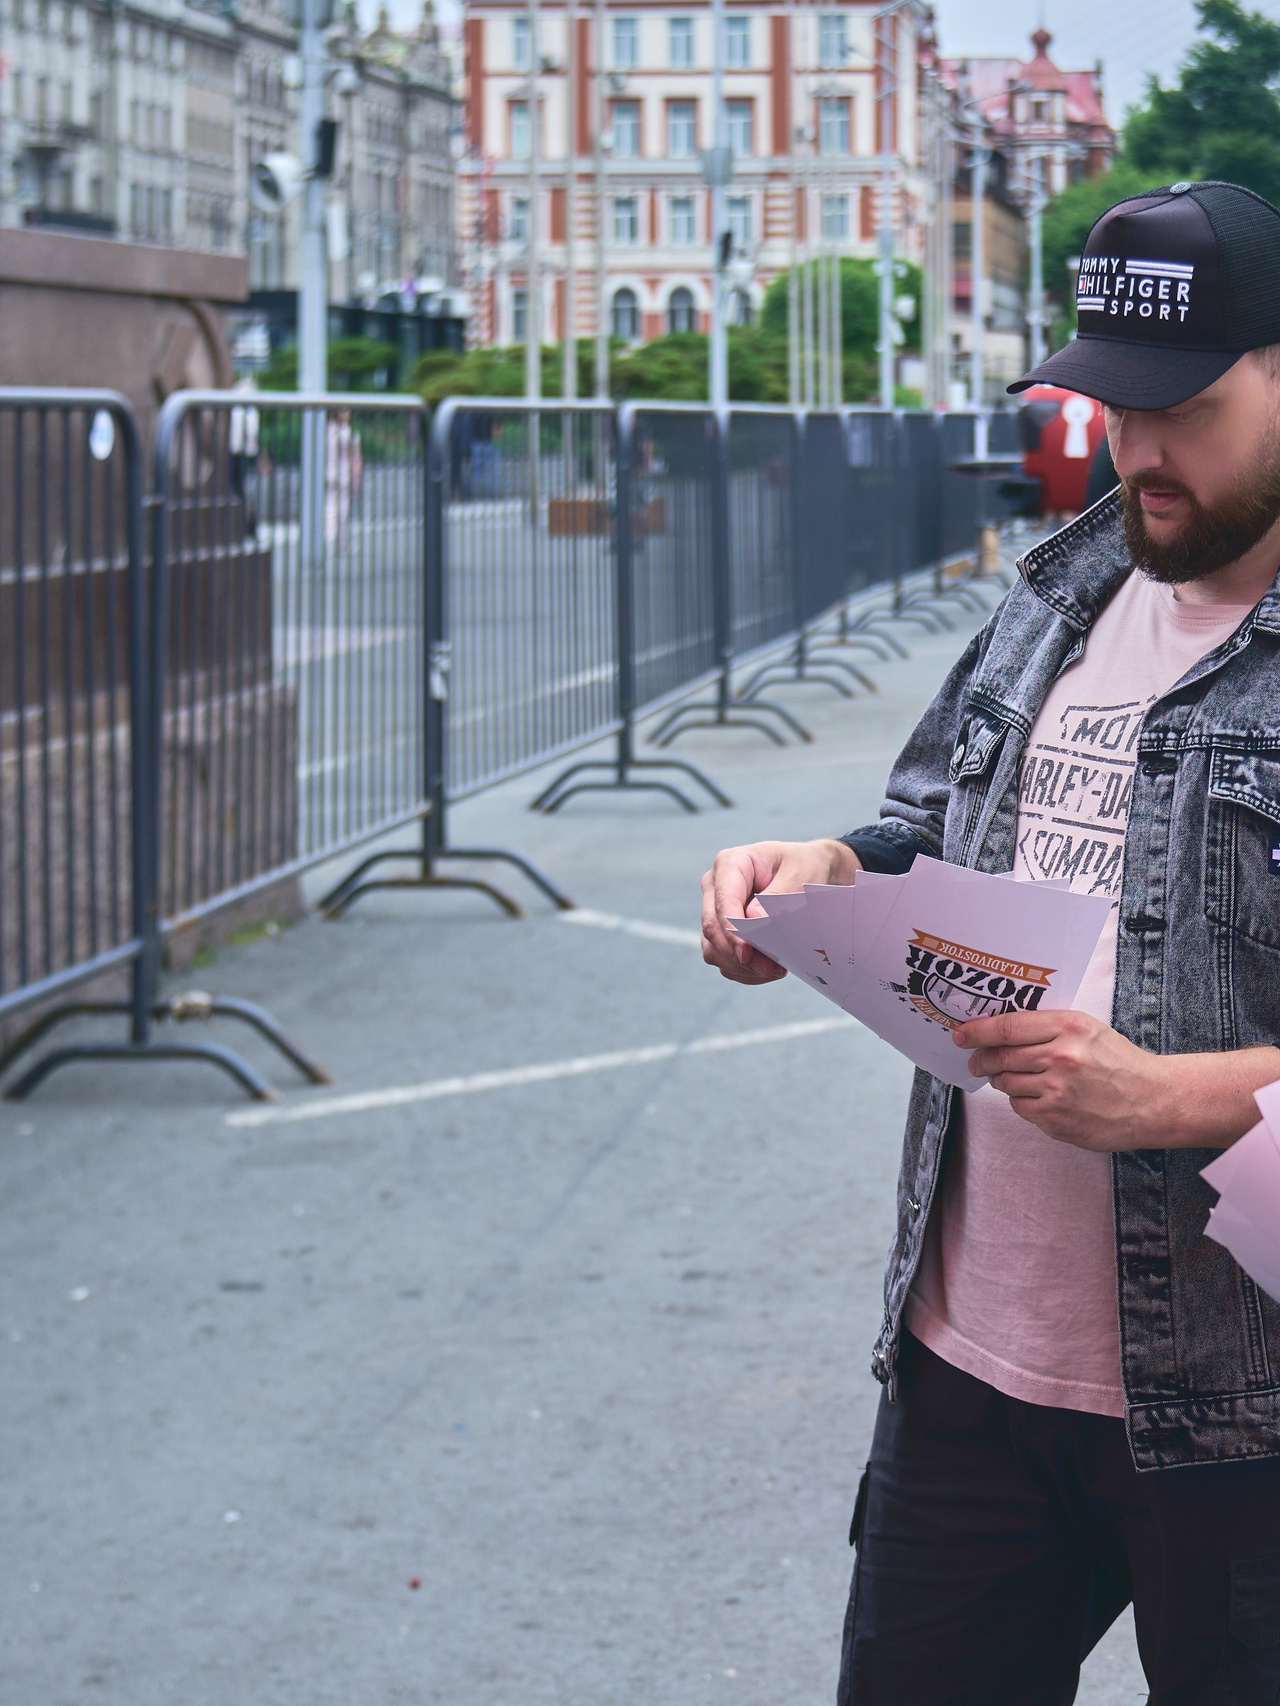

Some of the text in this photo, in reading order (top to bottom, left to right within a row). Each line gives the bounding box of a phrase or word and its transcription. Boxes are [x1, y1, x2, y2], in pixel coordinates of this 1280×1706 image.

[1080, 257, 1120, 274] TOMMY
[1085, 275, 1190, 303] HILFIGER
[1109, 299, 1189, 322] SPORT
[939, 942, 1025, 977] VLADIVOSTOK
[905, 944, 1047, 1011] DOZOR
